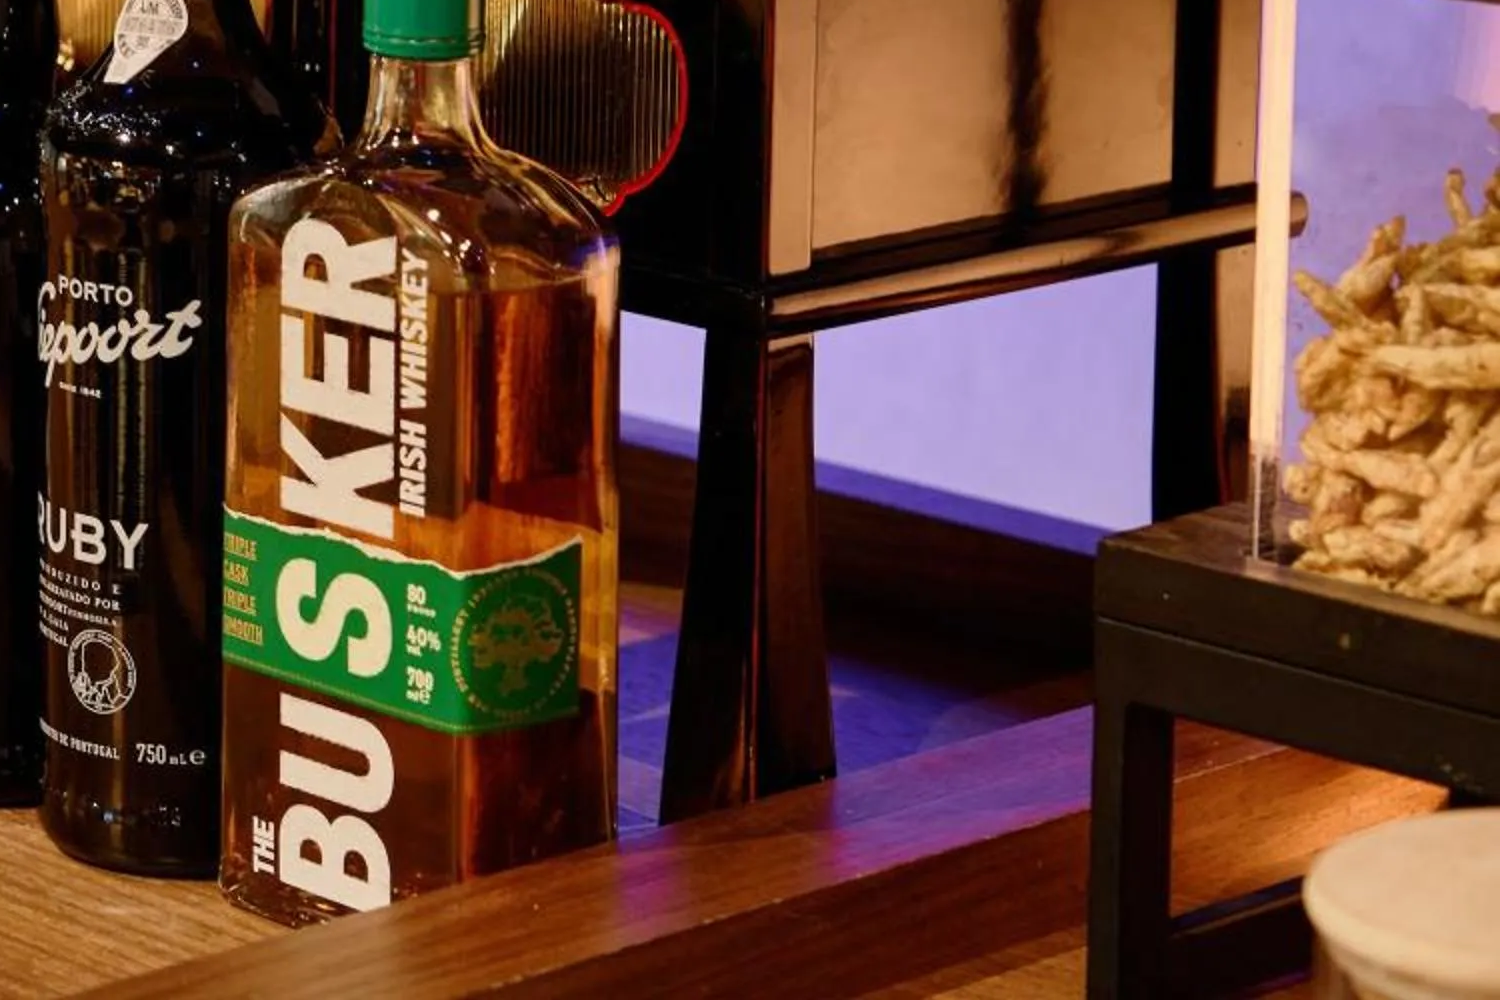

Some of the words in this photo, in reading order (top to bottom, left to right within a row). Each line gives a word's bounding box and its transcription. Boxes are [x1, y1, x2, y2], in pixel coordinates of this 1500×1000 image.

[58, 274, 134, 307] PORTO
[400, 247, 430, 410] WHISKEY
[400, 420, 427, 518] IRISH
[276, 217, 398, 913] BUSKER
[112, 583, 122, 595] E
[407, 583, 426, 605] 80
[406, 624, 442, 652] 40%
[407, 665, 435, 693] 700
[136, 743, 167, 765] 750
[253, 815, 275, 875] THE
